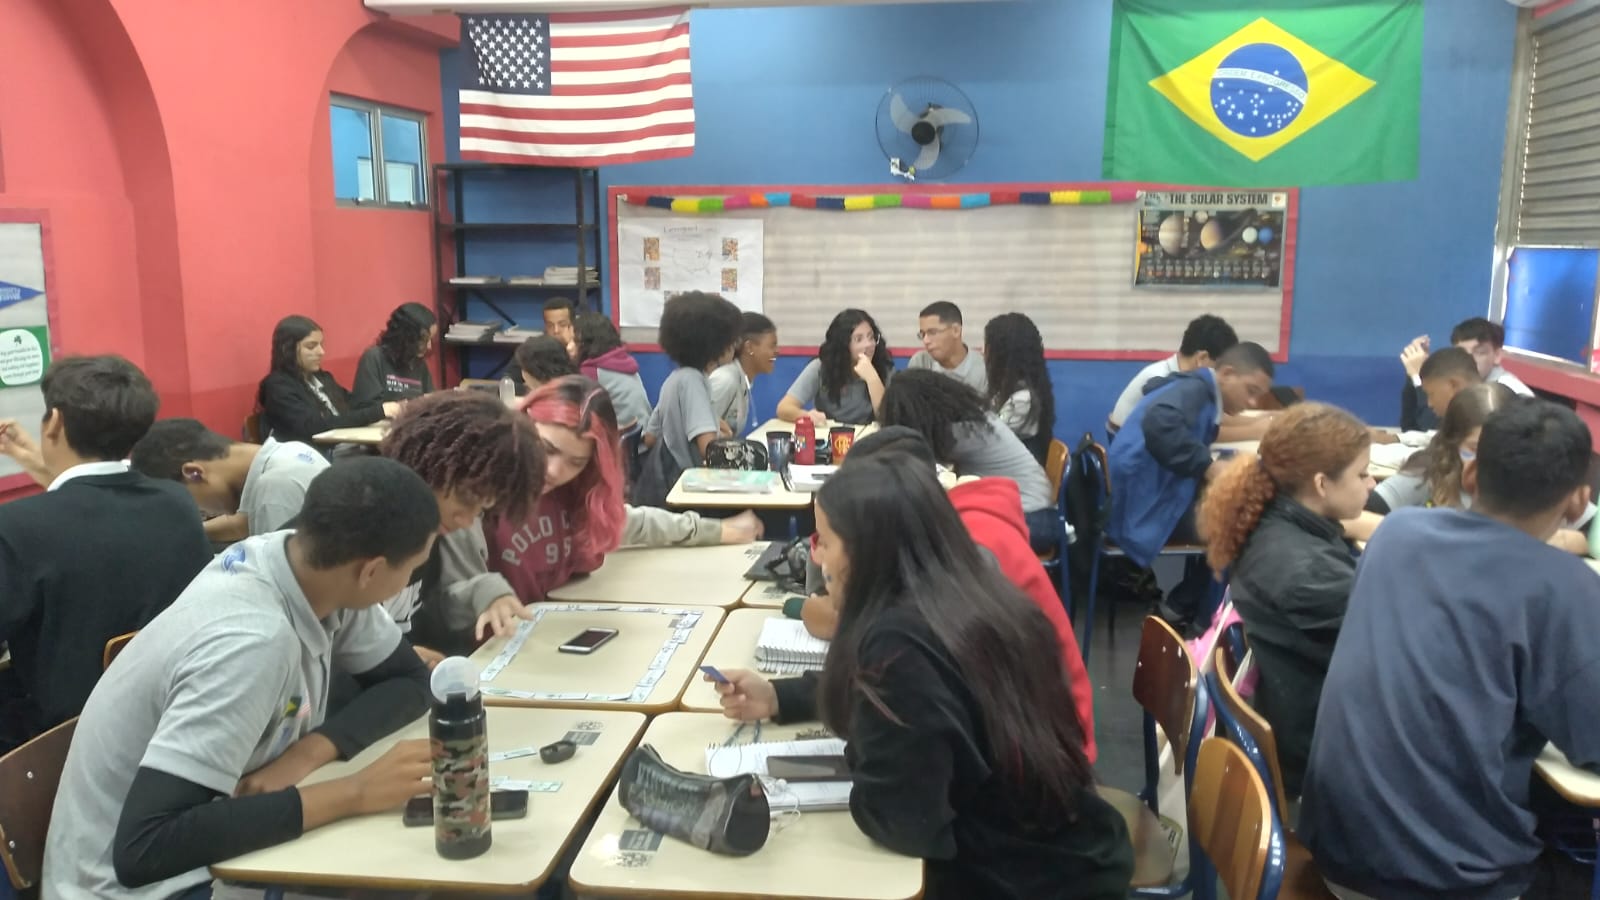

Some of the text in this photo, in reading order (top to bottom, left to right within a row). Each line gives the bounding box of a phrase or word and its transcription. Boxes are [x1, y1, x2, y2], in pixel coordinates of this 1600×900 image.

[1170, 193, 1187, 204] THE
[1190, 193, 1225, 204] SOLAR
[1226, 194, 1268, 204] SYSTEM
[502, 515, 553, 566] POLO
